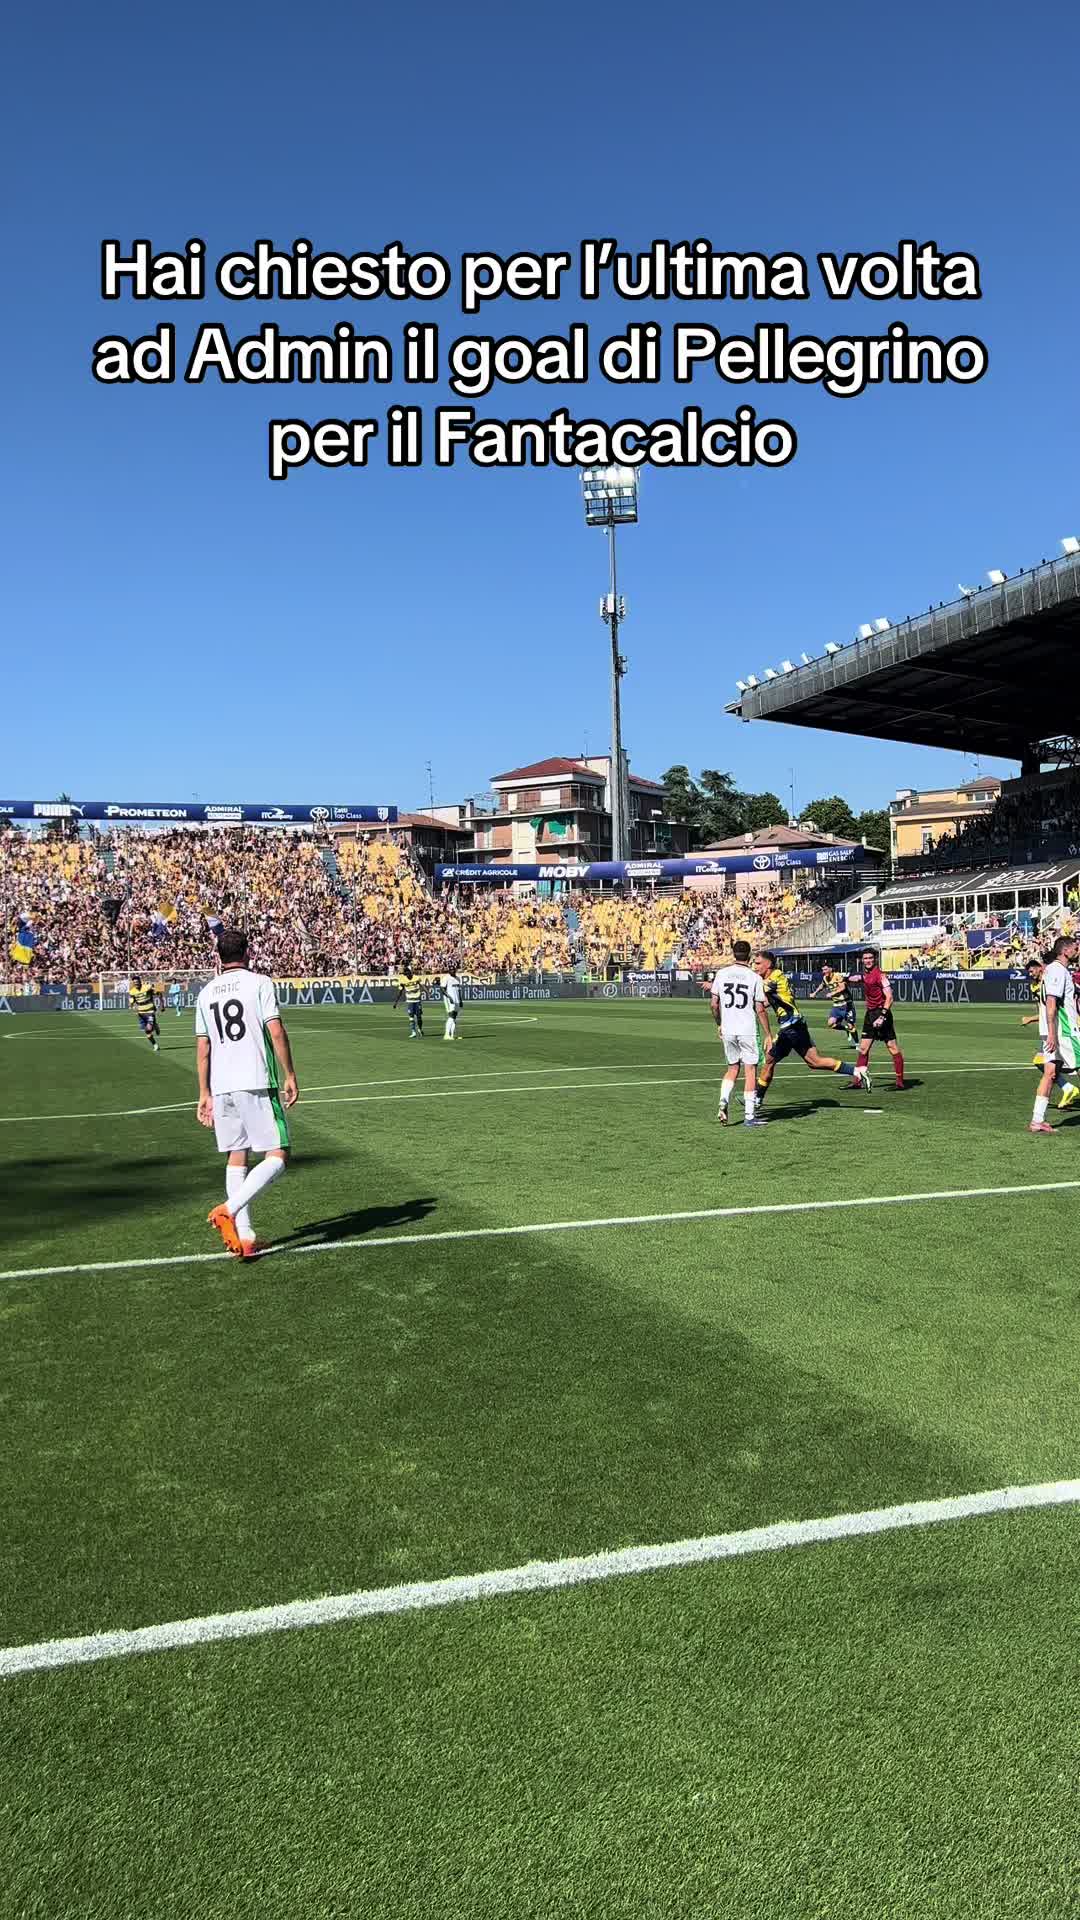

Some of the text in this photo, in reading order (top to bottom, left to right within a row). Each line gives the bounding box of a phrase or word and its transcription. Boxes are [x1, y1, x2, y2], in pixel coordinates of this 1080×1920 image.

[33, 803, 72, 816] PUMA
[104, 805, 187, 817] PROMETEON
[204, 805, 244, 813] ADMIRAL
[538, 866, 590, 877] MOBY
[624, 862, 664, 870] ADMIRAL
[276, 984, 374, 1006] UMARA
[429, 988, 440, 1000] 25
[464, 987, 470, 999] il
[472, 986, 510, 999] Salmone
[512, 986, 521, 998] di
[522, 986, 550, 999] Parma
[723, 983, 749, 1009] 35
[1006, 982, 1029, 1001] da 25
[62, 996, 74, 1010] da
[77, 996, 91, 1010] 25
[119, 993, 126, 1008] il
[210, 999, 246, 1044] 18
